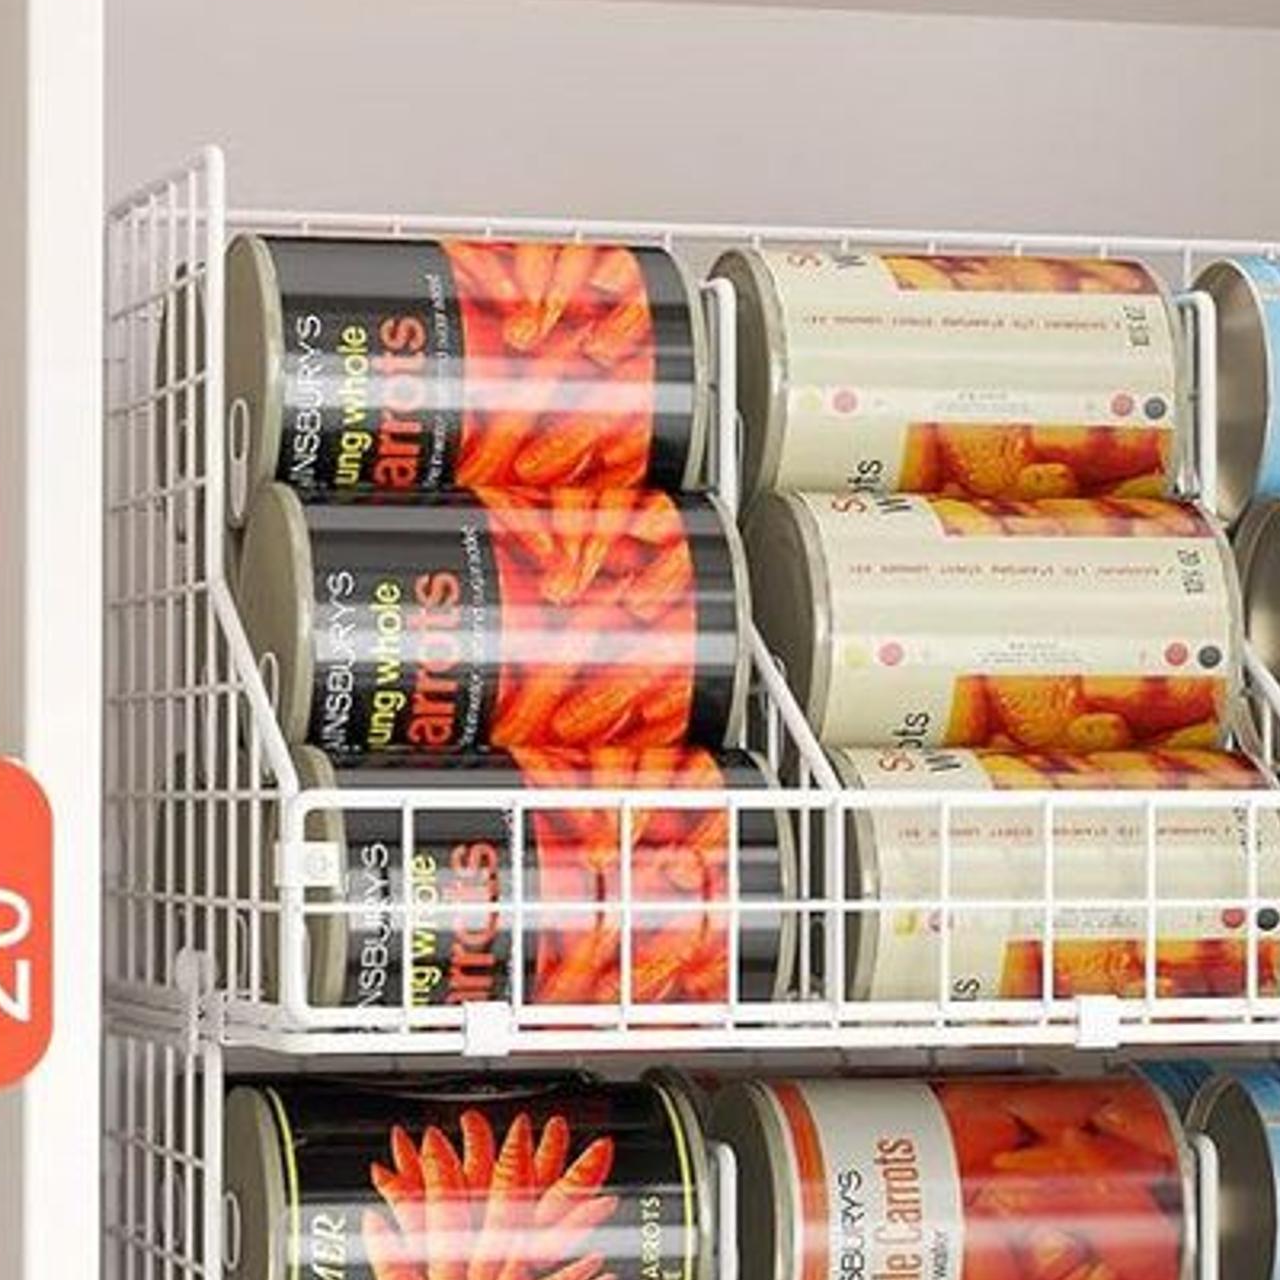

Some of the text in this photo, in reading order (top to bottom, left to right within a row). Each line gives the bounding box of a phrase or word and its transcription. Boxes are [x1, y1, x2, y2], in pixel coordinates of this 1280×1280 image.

[334, 325, 372, 485] ung whole
[371, 314, 427, 488] arrots
[366, 582, 408, 746] ung whole
[406, 571, 460, 746] arrots
[873, 1138, 923, 1246] Carrots
